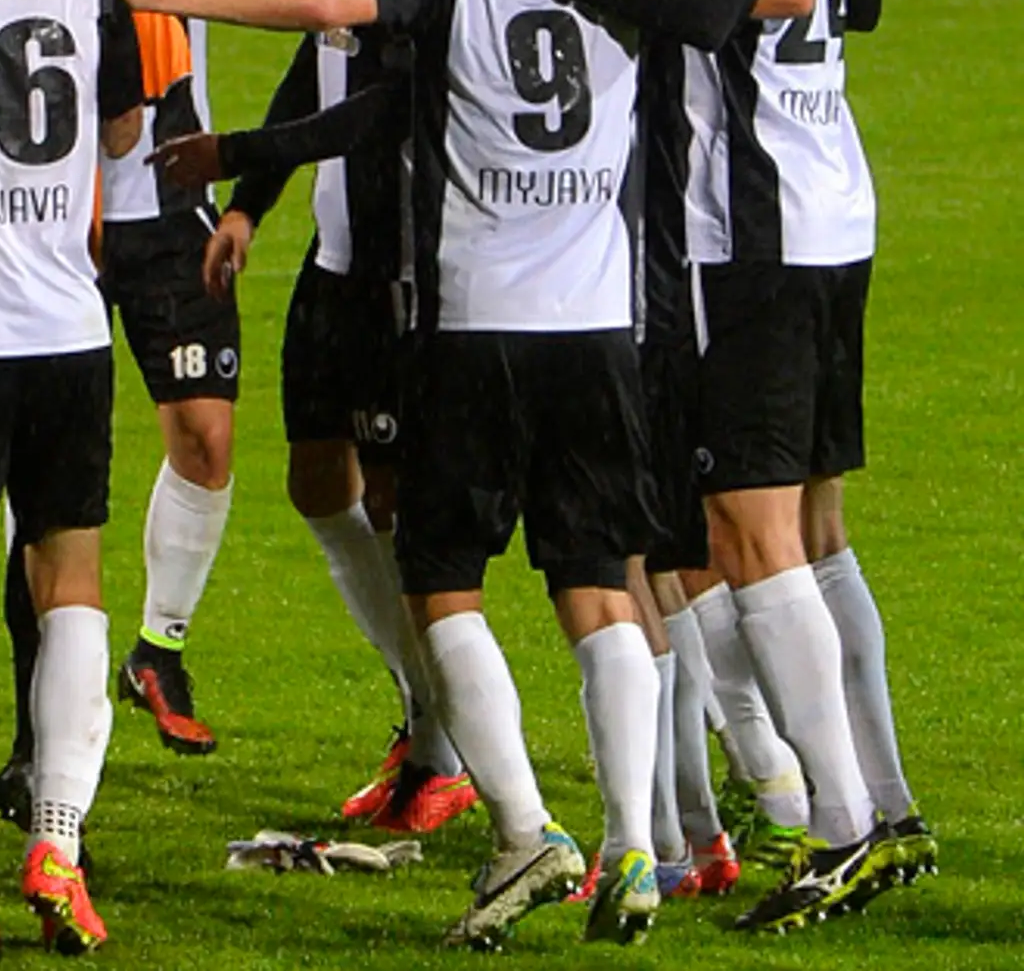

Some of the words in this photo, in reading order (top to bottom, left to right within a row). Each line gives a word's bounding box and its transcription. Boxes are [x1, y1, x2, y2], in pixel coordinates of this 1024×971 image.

[505, 9, 592, 152] 9
[478, 167, 613, 207] MYJAVA
[168, 342, 208, 380] 18
